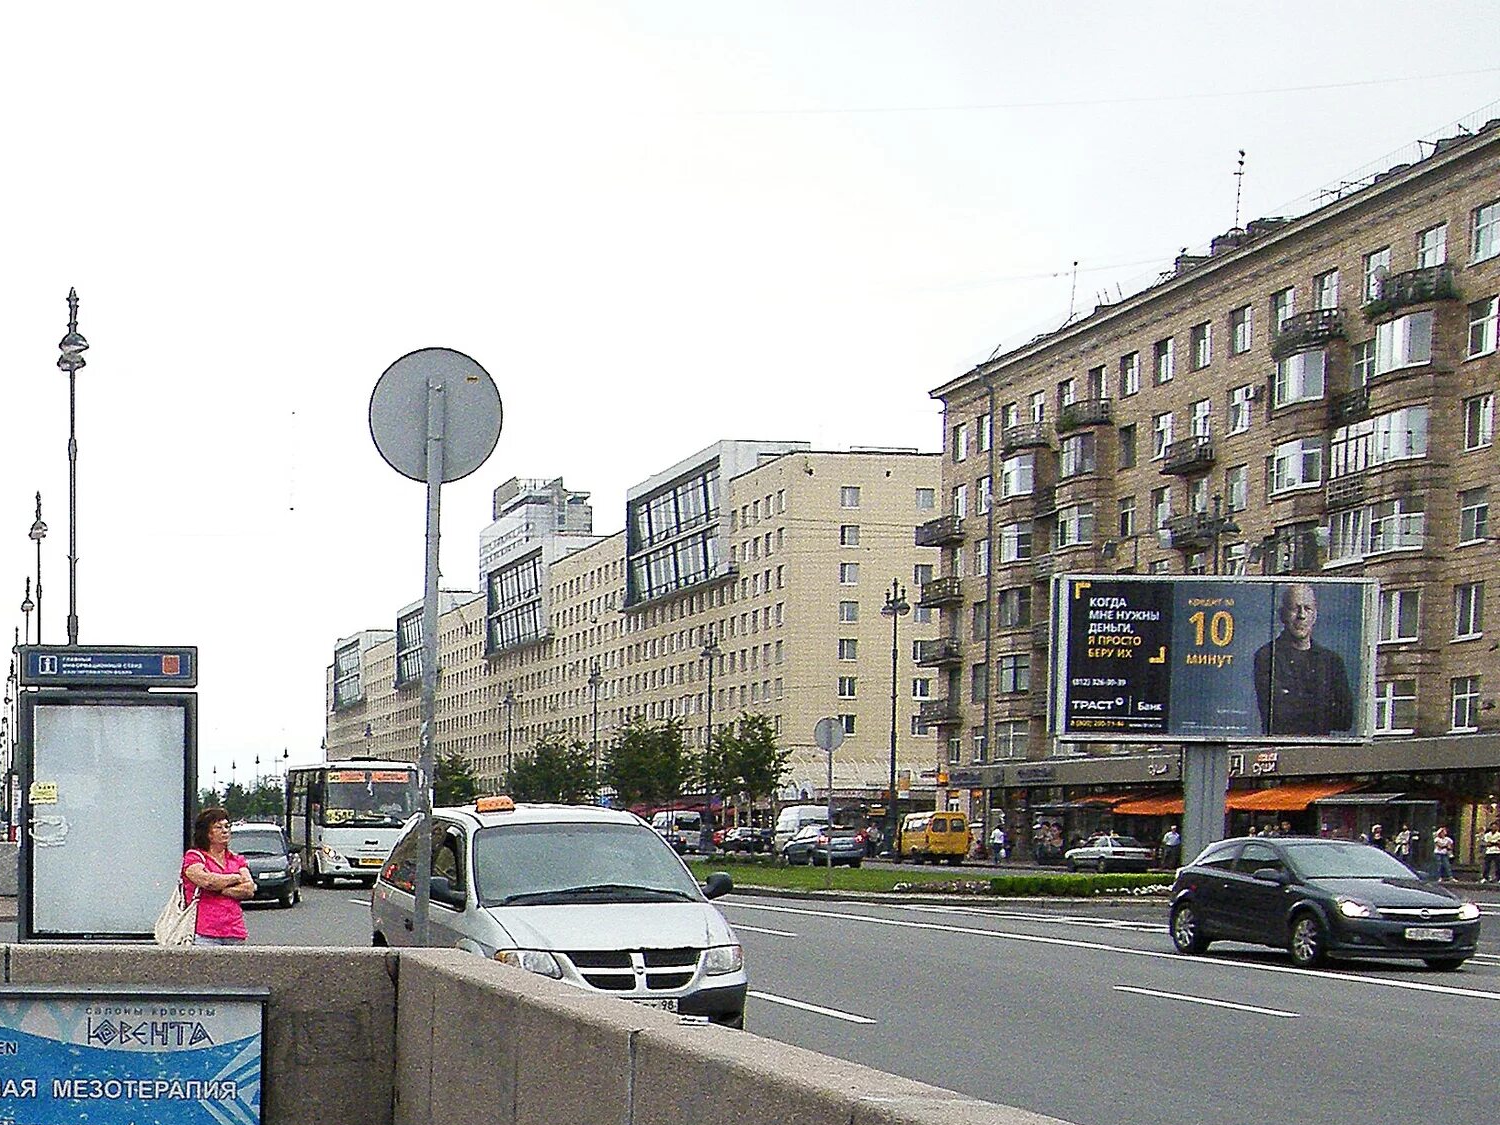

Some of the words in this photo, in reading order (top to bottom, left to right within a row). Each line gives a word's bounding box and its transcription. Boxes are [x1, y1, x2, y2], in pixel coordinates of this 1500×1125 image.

[1088, 597, 1127, 609] КОГДА
[1088, 609, 1113, 621] МНЕ
[1116, 610, 1160, 621] НУЖНЫ
[1087, 622, 1135, 635] ДЕНЬГИ,
[1188, 610, 1235, 647] 10
[1088, 635, 1095, 647] Я
[1097, 635, 1142, 647] ПРОСТО
[1087, 647, 1115, 659] БЕРУ
[1117, 648, 1133, 659] ИХ
[1071, 700, 1114, 710] ТРАСТ
[1137, 701, 1163, 712] Банк
[660, 1000, 674, 1010] 98
[87, 1017, 215, 1046] ЮВЕНТА
[52, 1079, 238, 1102] МЕЗОТЕРАПИЯ
